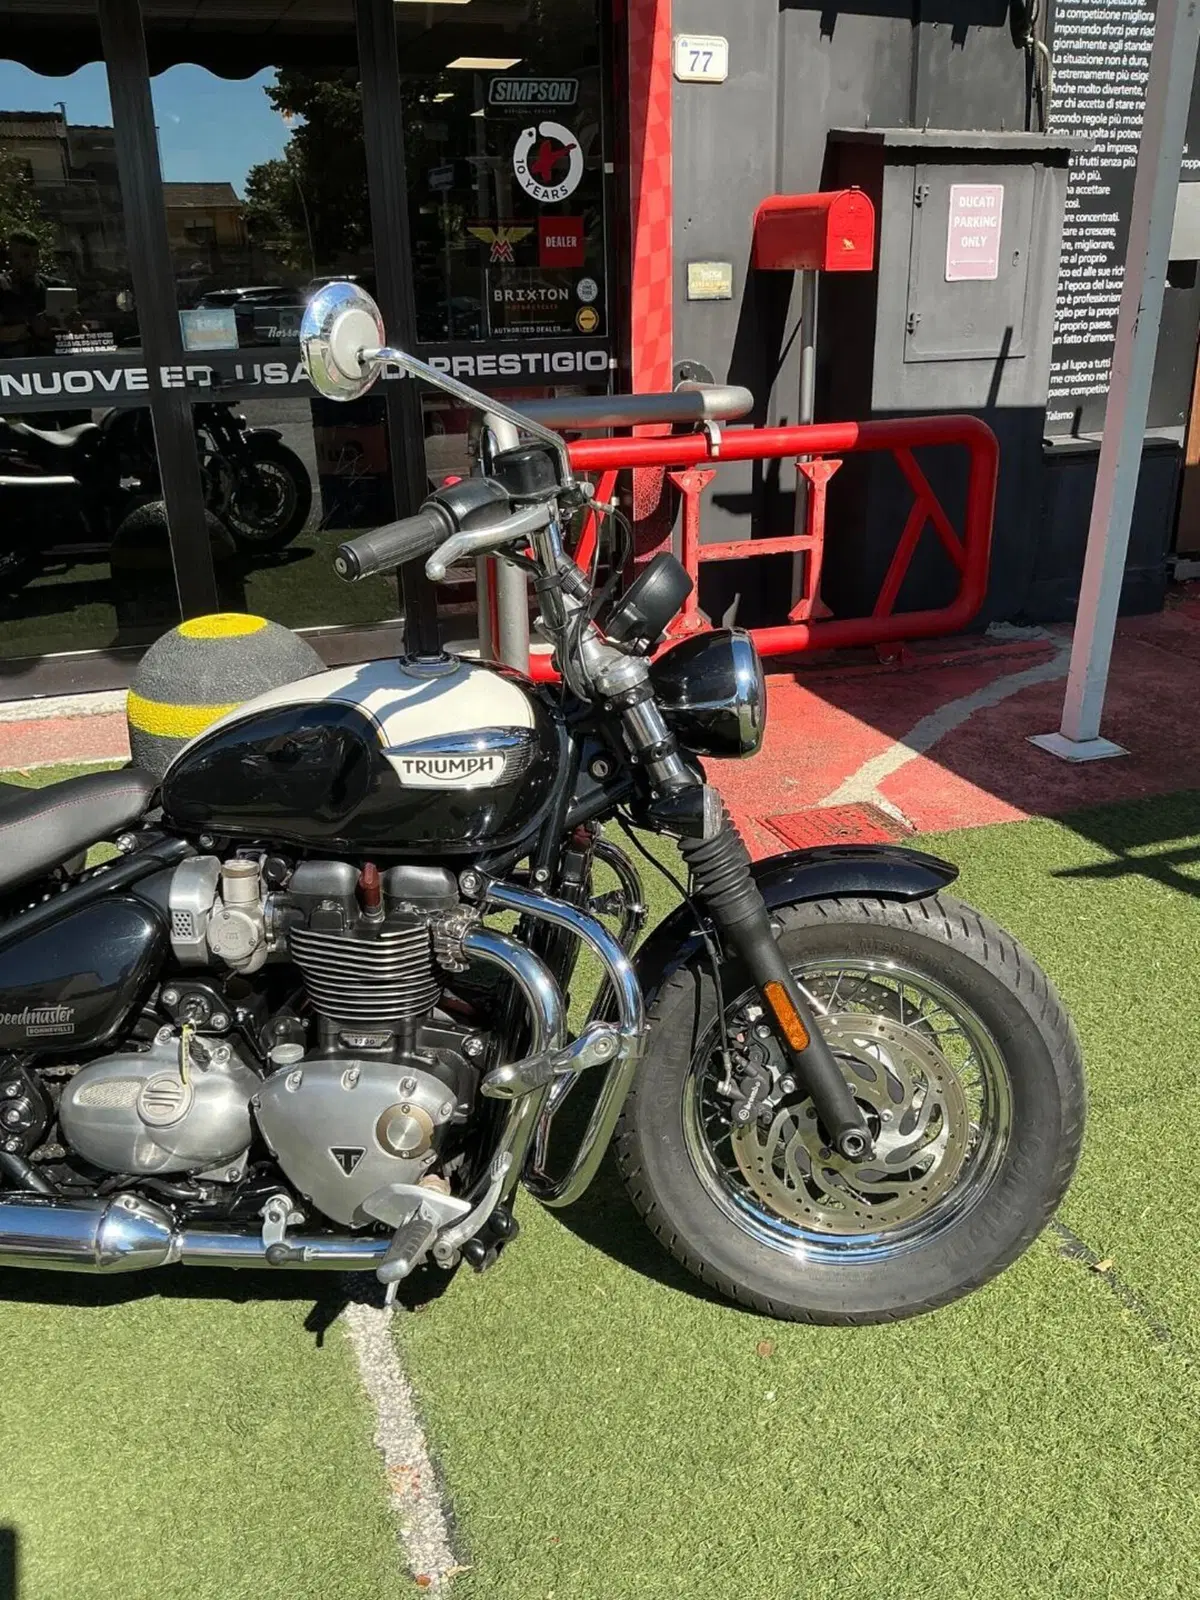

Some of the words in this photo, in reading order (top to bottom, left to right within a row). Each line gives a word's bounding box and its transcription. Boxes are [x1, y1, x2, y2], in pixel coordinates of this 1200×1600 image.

[1055, 7, 1065, 19] La
[1066, 8, 1121, 22] competizione
[1121, 9, 1155, 24] migliora
[1054, 22, 1101, 36] imponendo
[1102, 23, 1124, 36] sforzi
[1125, 27, 1139, 39] per
[1053, 37, 1108, 51] giornalmente
[1108, 39, 1123, 53] agli
[689, 50, 713, 72] 77
[1052, 53, 1062, 64] La
[1063, 53, 1104, 65] situazione
[1104, 56, 1121, 65] non
[1122, 54, 1127, 66] è
[1129, 54, 1149, 67] dura,
[1058, 69, 1115, 80] estremamente
[1116, 70, 1130, 82] più
[495, 81, 572, 101] SIMPSON
[1052, 82, 1076, 94] Anche
[1077, 83, 1101, 94] molto
[1102, 84, 1143, 96] divertente,
[1064, 97, 1076, 108] chi
[1077, 98, 1105, 108] accetta
[1106, 97, 1115, 108] di
[1115, 99, 1135, 109] stare
[1049, 112, 1081, 124] secondo
[1083, 113, 1107, 126] regole
[1108, 113, 1122, 126] più
[1089, 128, 1109, 139] volta
[1110, 128, 1116, 138] si
[1107, 142, 1138, 155] impresa,
[1079, 156, 1100, 167] frutti
[1100, 158, 1122, 167] senza
[1122, 157, 1136, 169] più
[515, 159, 526, 174] 10
[525, 179, 569, 199] YEARS
[1069, 170, 1086, 182] può
[1087, 170, 1102, 182] più.
[1075, 185, 1111, 195] accettare
[959, 195, 995, 208] DUCATI
[1065, 198, 1081, 208] così.
[954, 216, 998, 228] PARKING
[1076, 212, 1120, 222] concentrati.
[1078, 228, 1084, 236] a
[1085, 227, 1116, 237] crescere,
[545, 236, 577, 248] DEALER
[961, 236, 988, 248] ONLY
[1074, 239, 1115, 252] migliorare,
[1070, 253, 1078, 263] al
[1078, 253, 1107, 265] proprio
[1072, 267, 1082, 277] ed
[1083, 266, 1097, 277] alle
[1098, 268, 1111, 276] sue
[1064, 280, 1091, 292] l'epoca
[1092, 279, 1105, 290] del
[493, 288, 569, 302] BRIXTON
[1067, 294, 1072, 304] è
[1074, 309, 1087, 319] per
[1088, 306, 1096, 316] la
[494, 326, 535, 335] AUTHORIZED
[536, 325, 561, 333] DEALER
[1060, 320, 1088, 332] proprio
[1089, 321, 1113, 331] paese.
[1063, 334, 1082, 344] fatto
[1083, 333, 1116, 343] d'amore.
[1062, 360, 1069, 370] al
[1070, 360, 1087, 371] lupo
[1088, 361, 1093, 369] a
[1094, 358, 1111, 368] tutti
[0, 367, 150, 396] NUOVE
[159, 365, 214, 388] ED
[428, 350, 608, 377] PRESTIGIO
[1064, 372, 1095, 383] credono
[1096, 371, 1108, 381] nel
[1048, 388, 1070, 399] paese
[1046, 411, 1074, 421] Talamo
[402, 757, 493, 780] TRIUMPH
